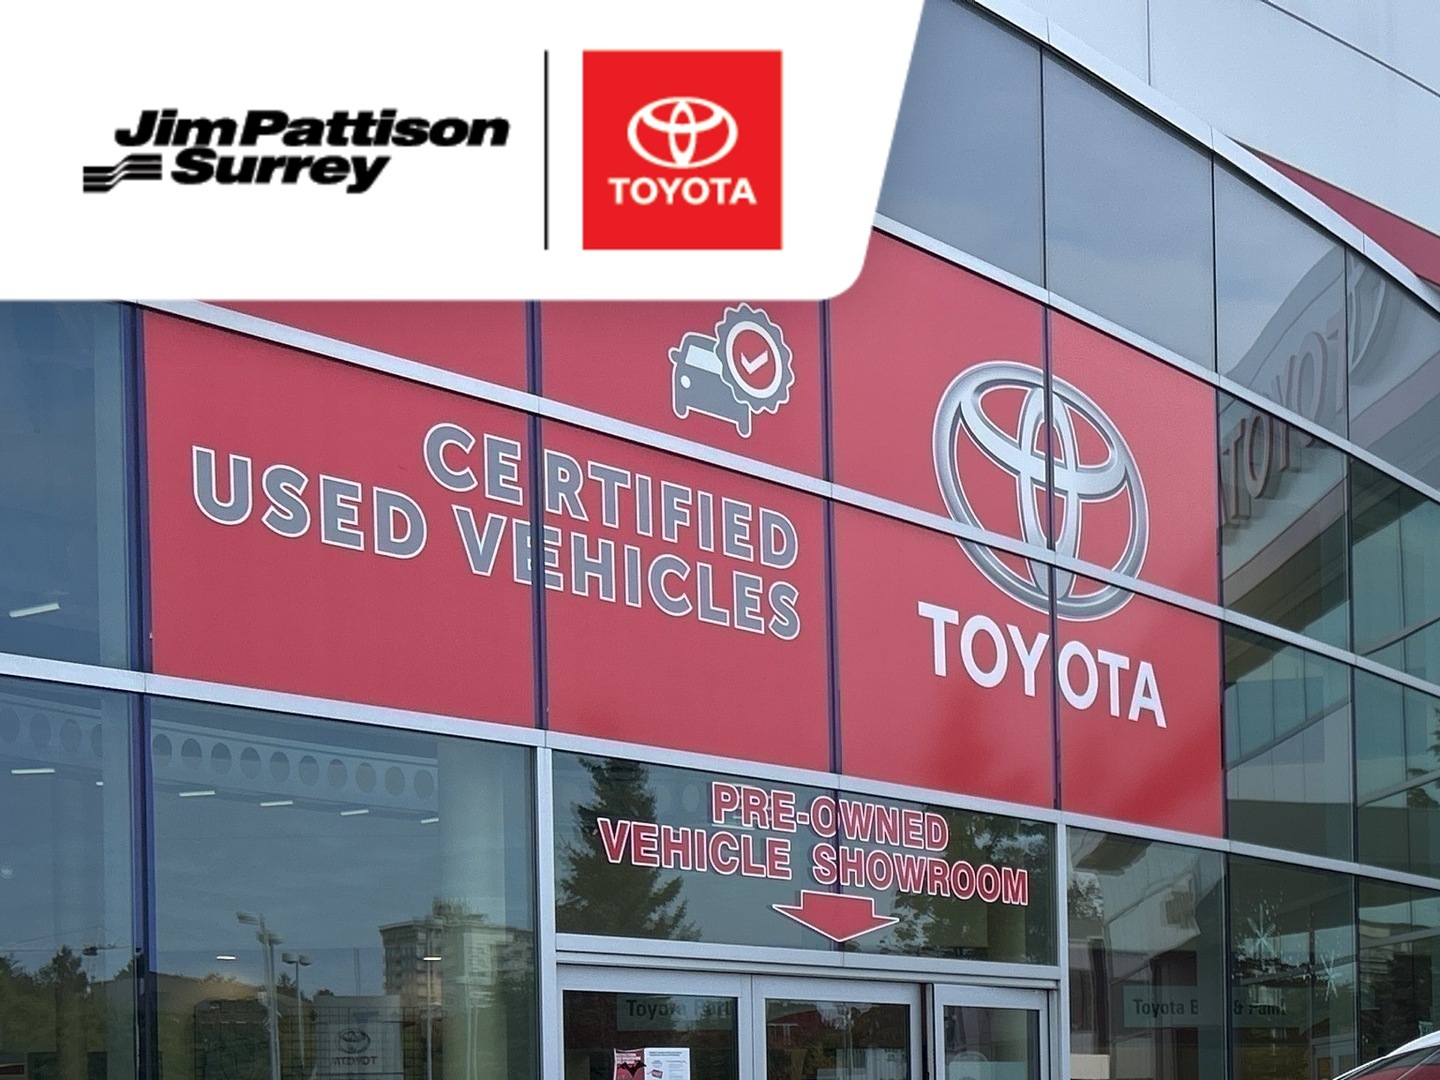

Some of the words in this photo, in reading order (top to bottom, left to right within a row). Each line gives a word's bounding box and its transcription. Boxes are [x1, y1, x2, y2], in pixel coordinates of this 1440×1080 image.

[423, 423, 800, 570] CERTIFIED
[191, 446, 428, 560] USED
[451, 504, 801, 641] VEHICLES
[917, 600, 1168, 729] TOYOTA
[711, 781, 950, 852] PRE-OWNED
[597, 817, 793, 881] VEHICLE
[812, 843, 1029, 906] SHOWROOM
[1133, 999, 1185, 1018] Toyota
[1233, 1000, 1245, 1016] &
